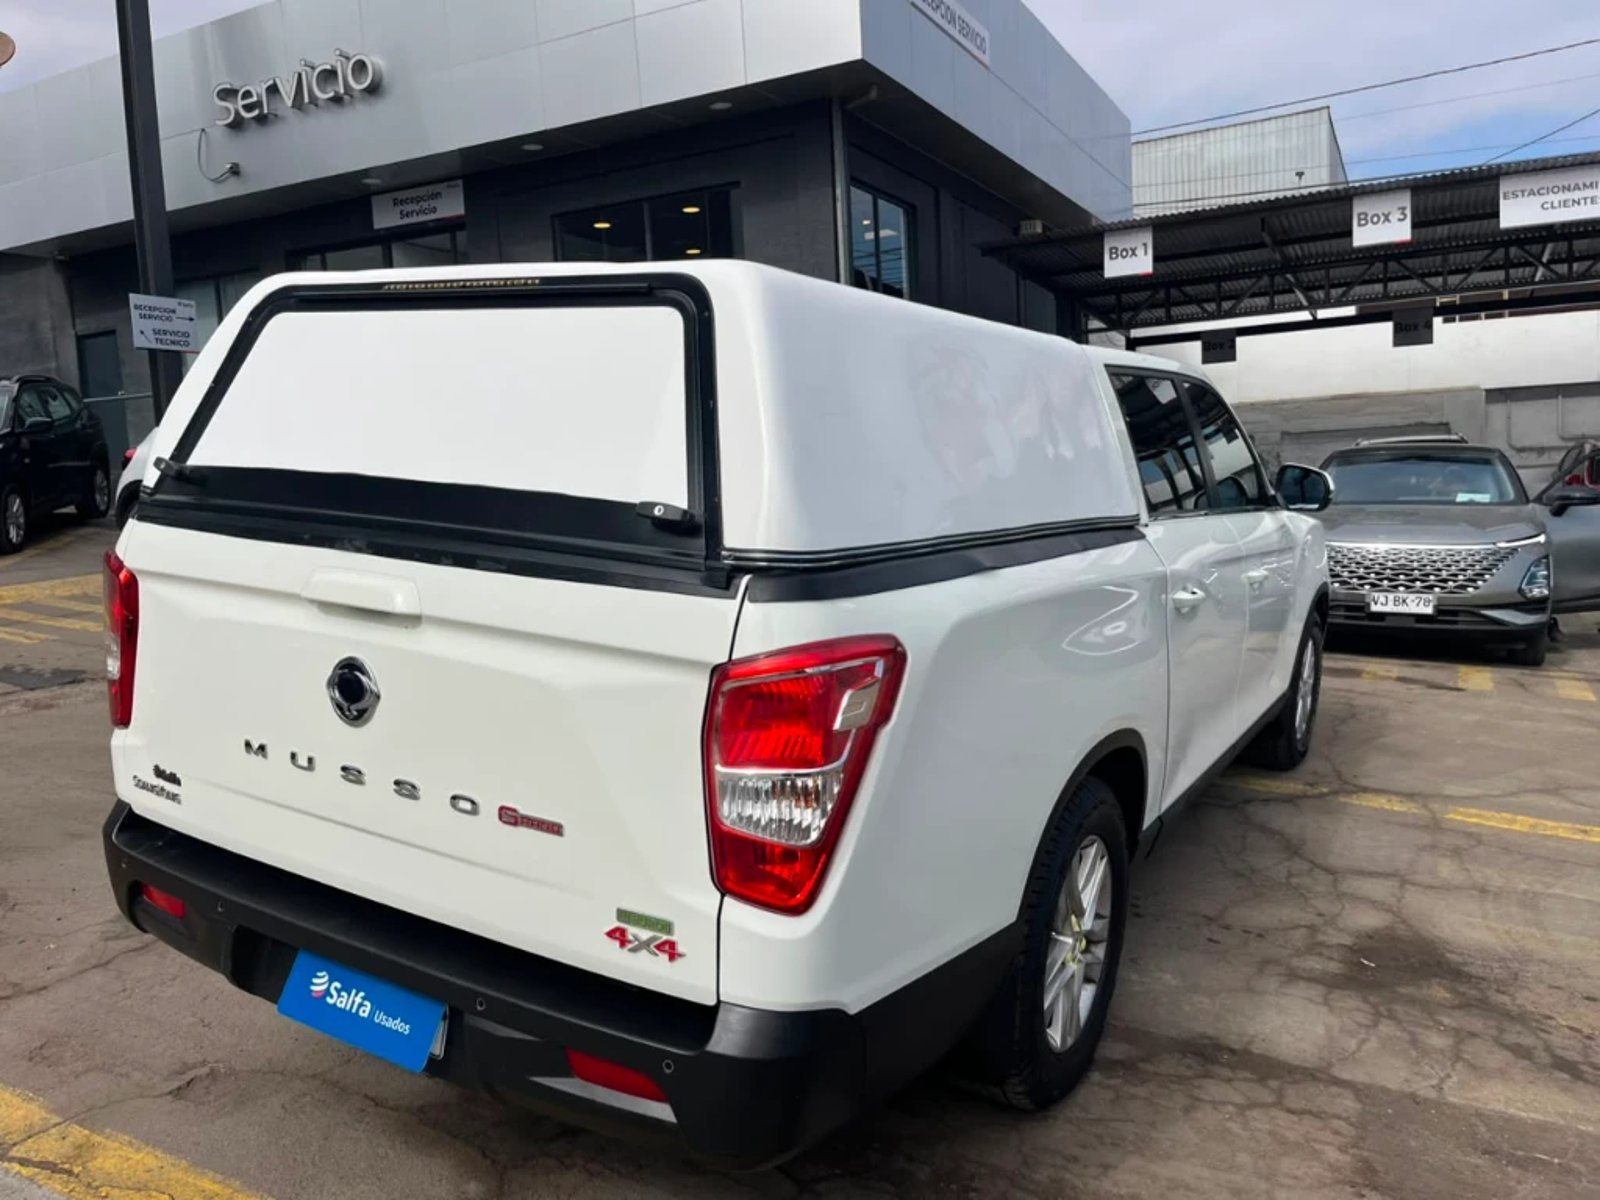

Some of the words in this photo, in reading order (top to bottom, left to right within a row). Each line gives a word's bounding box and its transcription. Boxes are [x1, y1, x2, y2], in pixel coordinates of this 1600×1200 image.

[213, 48, 378, 127] Servicio
[399, 203, 438, 220] Servicio
[1357, 211, 1392, 227] Box
[1397, 206, 1408, 222] 3
[1109, 246, 1138, 260] Box
[1142, 242, 1148, 256] 1
[138, 313, 173, 322] SERVICIO
[152, 328, 190, 338] SERVICIO
[244, 738, 481, 817] MUSSO
[325, 980, 372, 1018] Salfa
[374, 1010, 412, 1036] Usados
